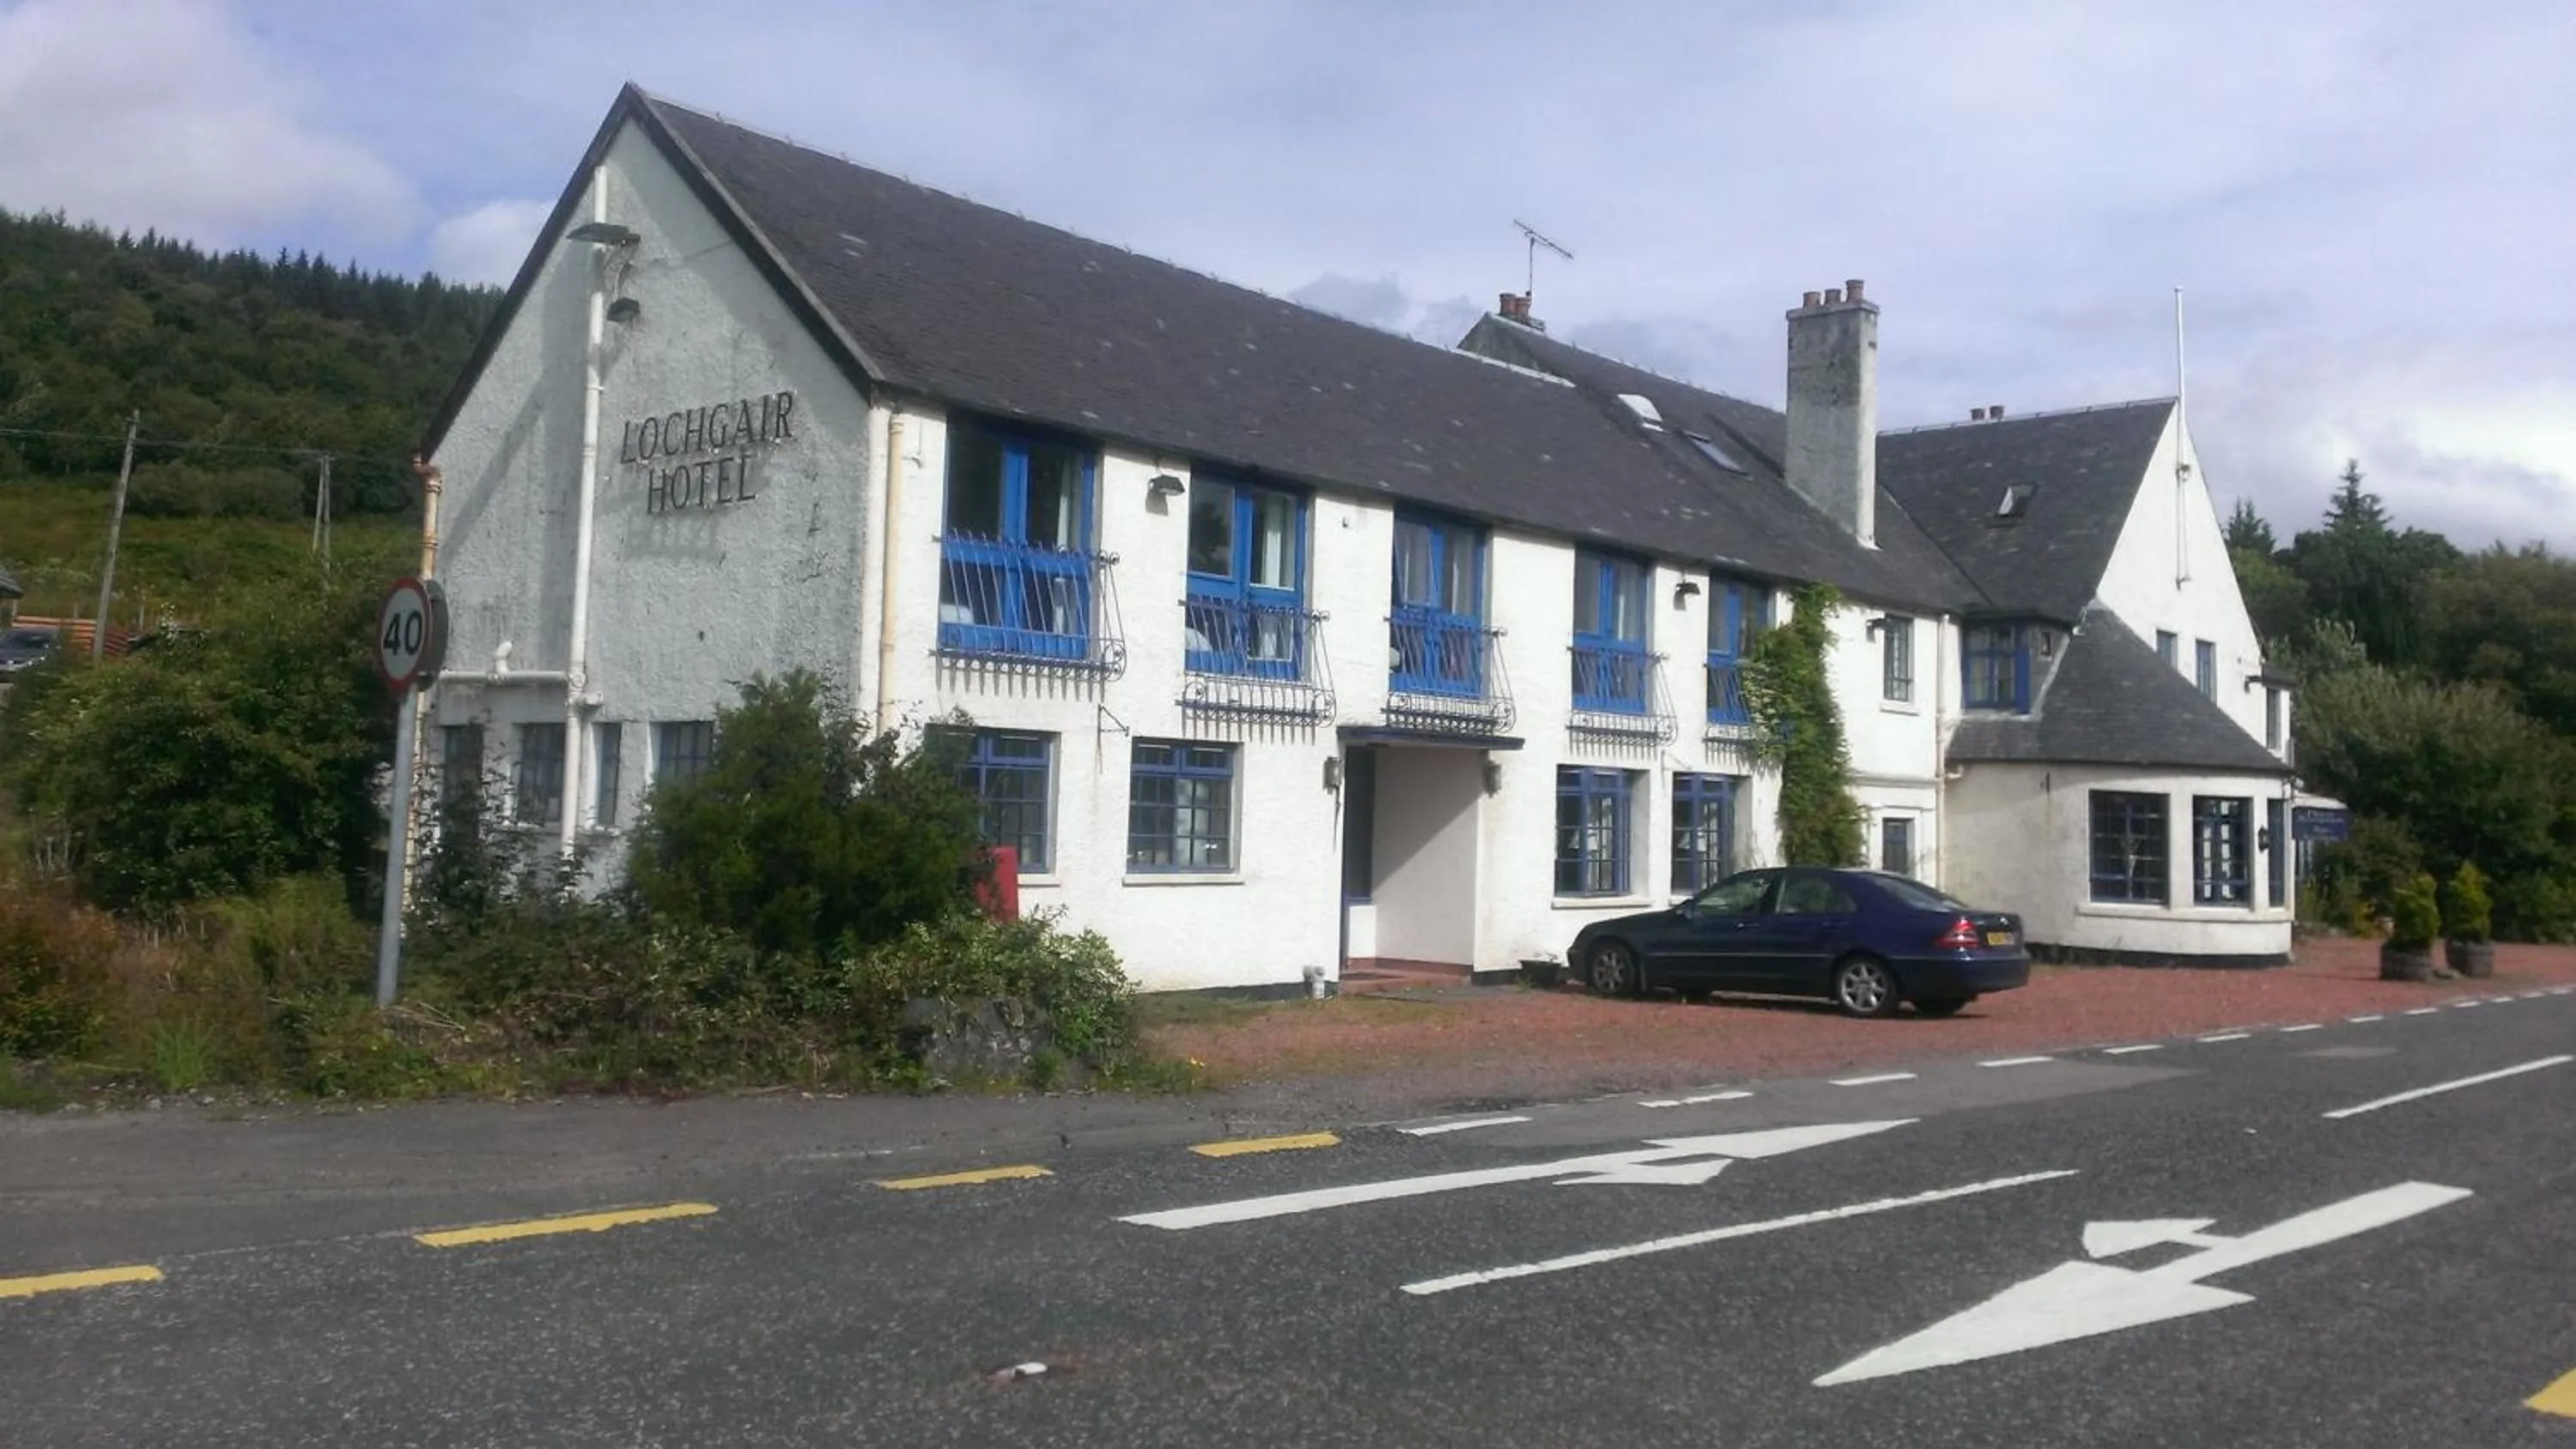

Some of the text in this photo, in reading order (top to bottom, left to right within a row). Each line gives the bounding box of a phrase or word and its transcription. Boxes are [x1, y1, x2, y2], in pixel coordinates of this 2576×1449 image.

[620, 391, 794, 464] LOCHGAIR
[647, 449, 756, 514] HOTEL
[384, 610, 422, 655] 40
